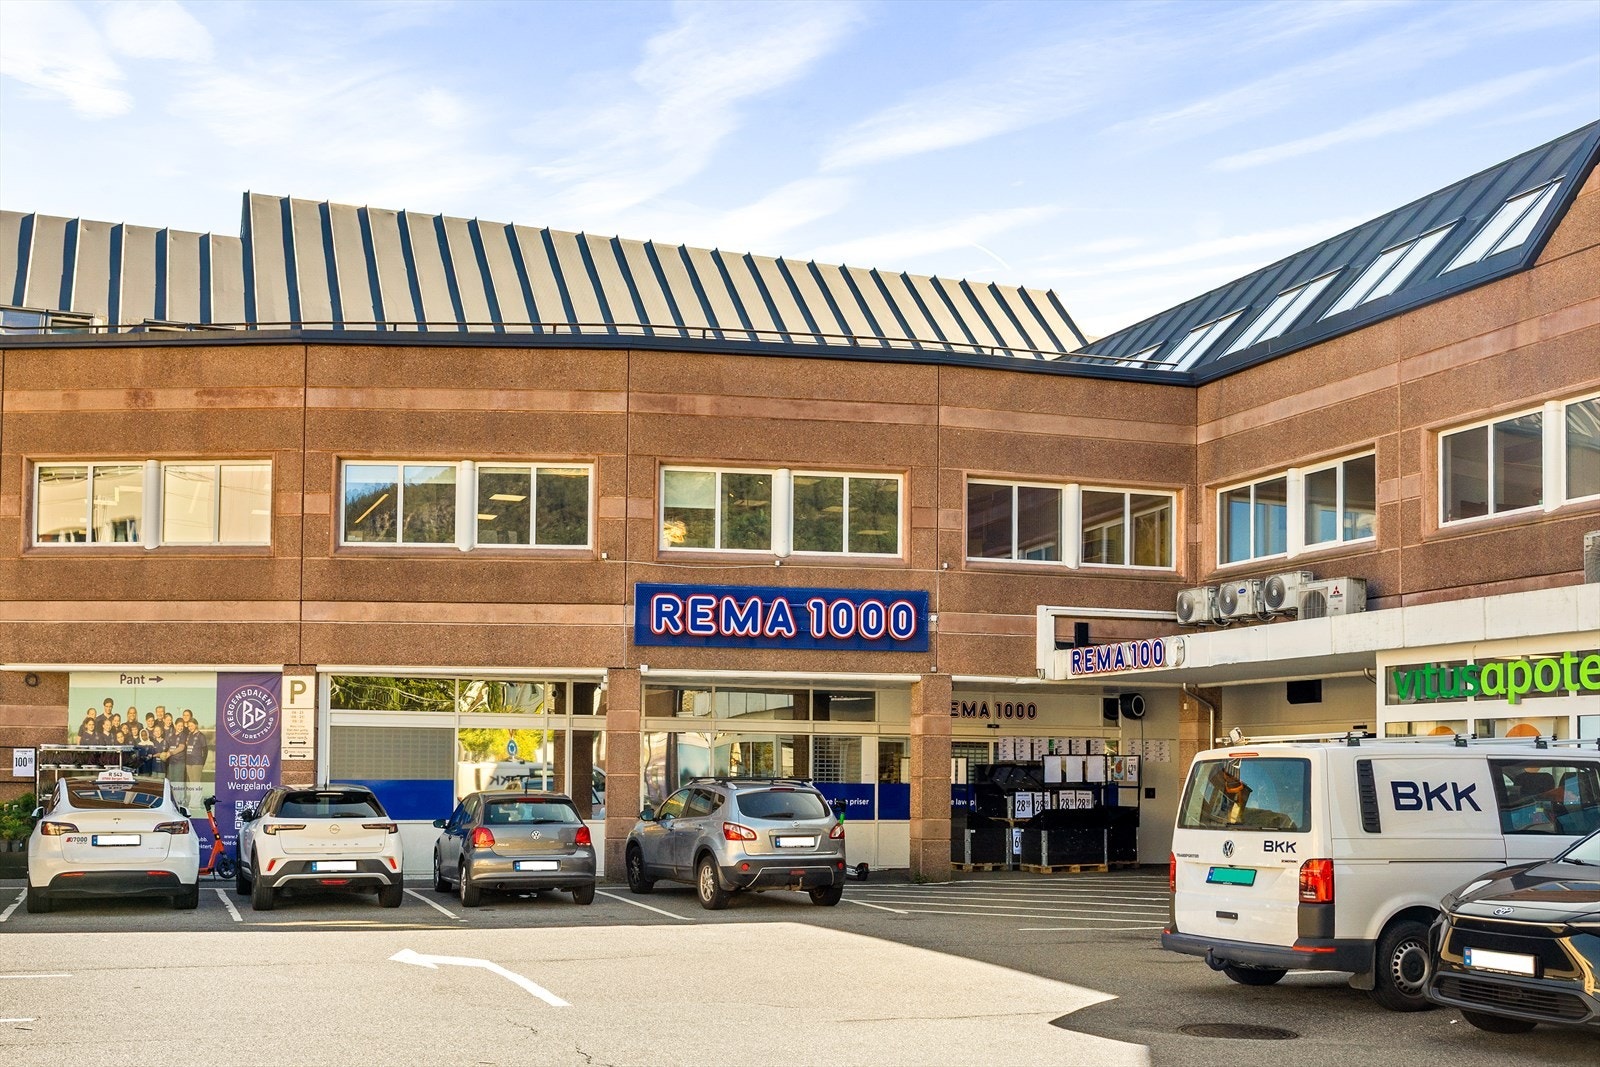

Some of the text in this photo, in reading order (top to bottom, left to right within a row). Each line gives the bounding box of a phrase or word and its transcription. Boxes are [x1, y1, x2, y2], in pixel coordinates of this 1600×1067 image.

[651, 593, 917, 641] REMA 1000
[1071, 643, 1126, 675] REMA
[120, 674, 145, 685] Pant
[1393, 651, 1600, 705] vitusapote
[290, 680, 307, 704] P
[226, 688, 272, 728] BERGENSDALEN
[950, 700, 1037, 720] EMA 1000
[15, 757, 27, 767] 100
[228, 754, 270, 767] REMA
[233, 767, 266, 780] 1000
[227, 781, 272, 792] Wergeland
[850, 798, 869, 806] priser
[1390, 780, 1483, 811] BKK
[1263, 840, 1297, 853] BKK
